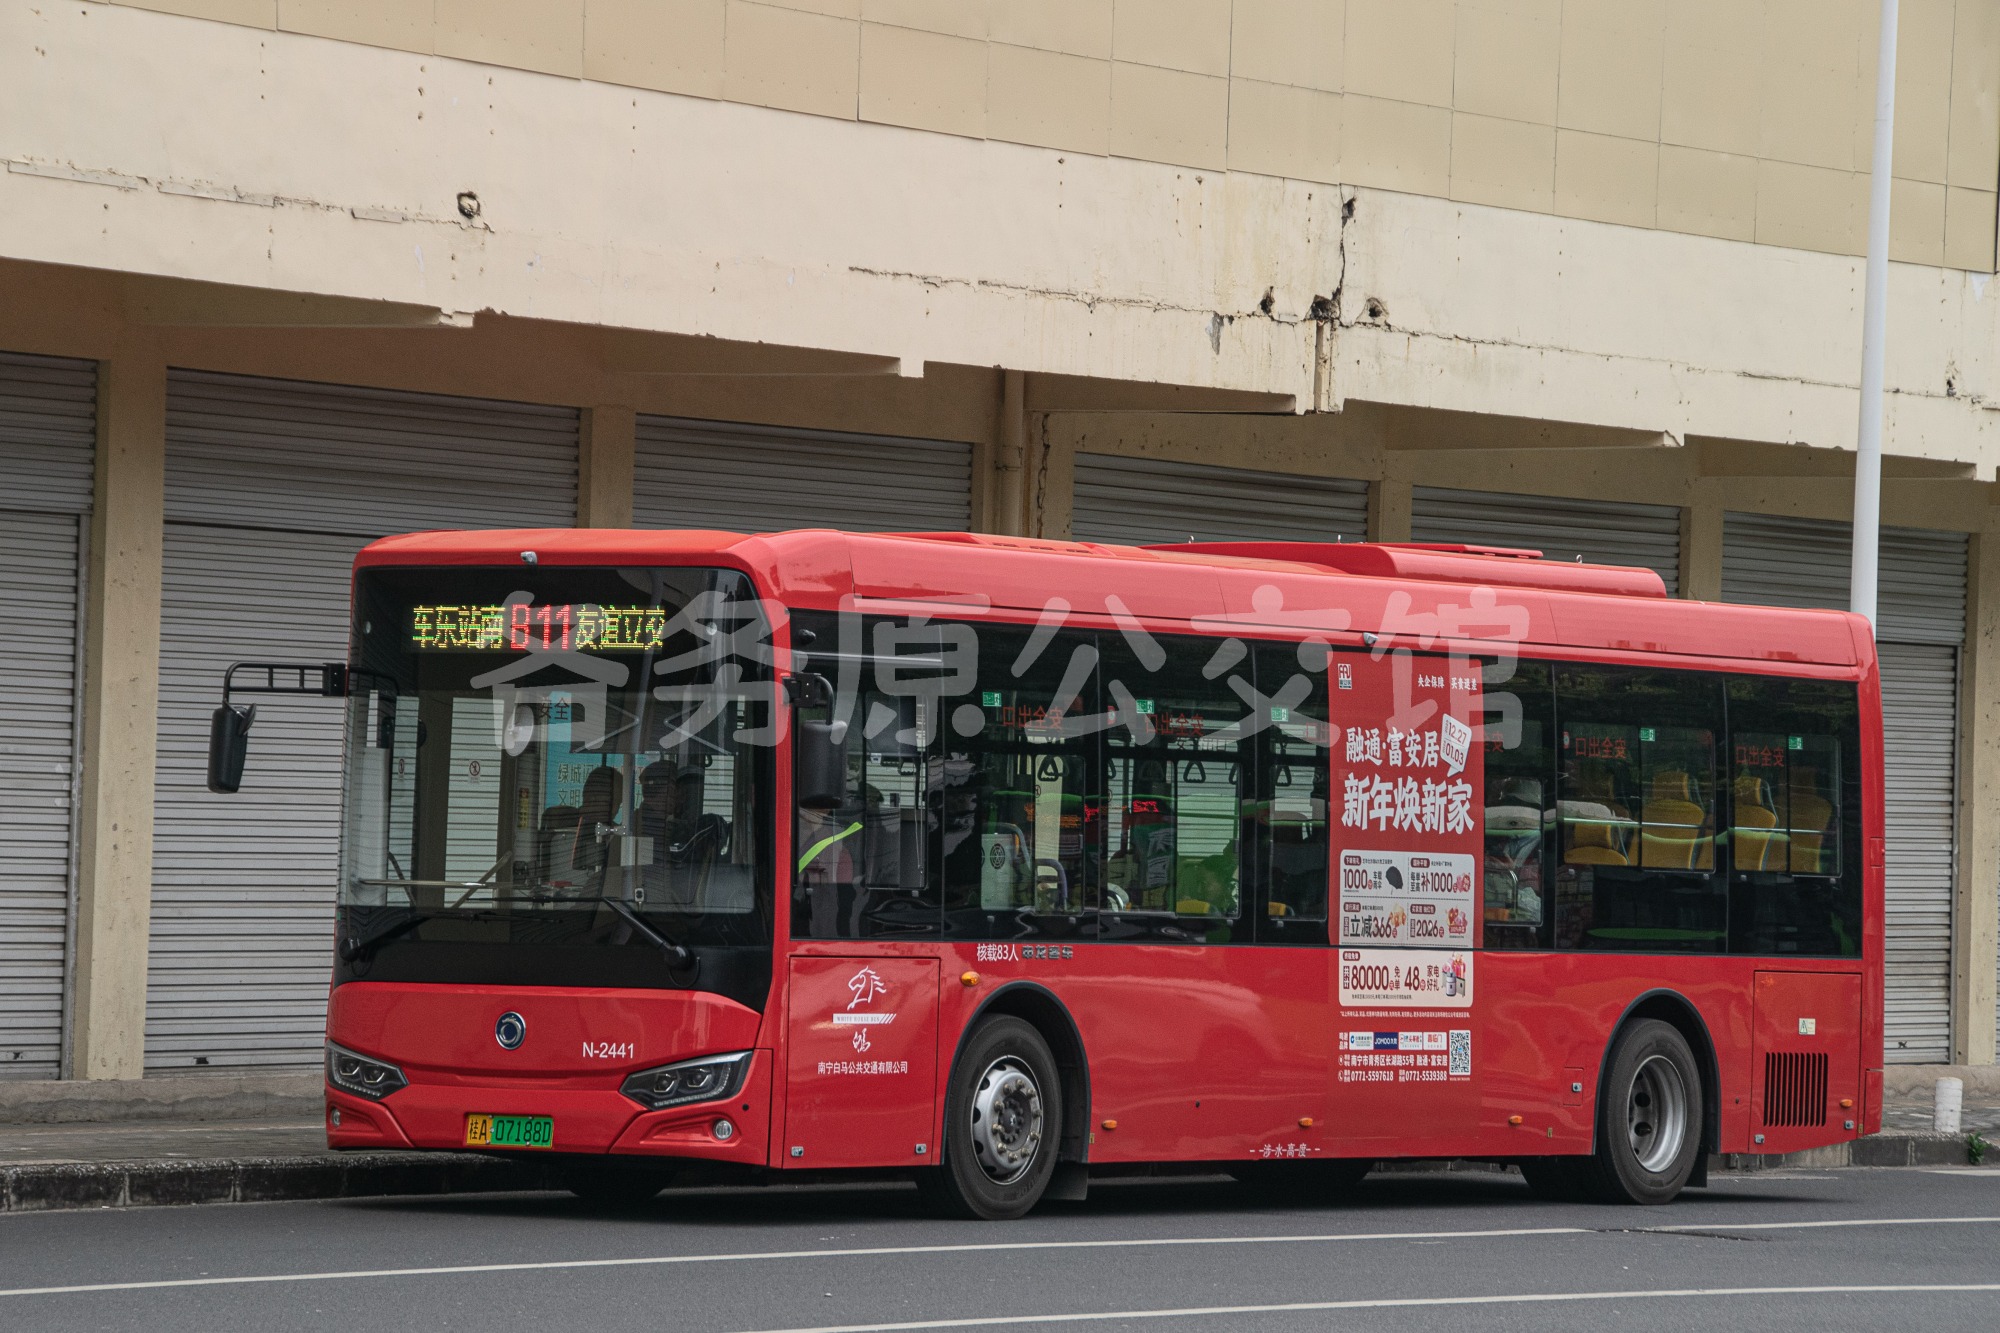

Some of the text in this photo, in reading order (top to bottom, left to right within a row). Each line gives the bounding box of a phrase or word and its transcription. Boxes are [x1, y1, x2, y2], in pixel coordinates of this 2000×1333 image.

[511, 604, 570, 650] B11
[1346, 727, 1440, 769] 融通·富安居
[1342, 772, 1475, 835] 新年焕新家
[977, 943, 1019, 961] 核载83人
[582, 1042, 635, 1059] N-2441
[818, 1061, 908, 1075] 南宁白马公共交通有限公司
[469, 1119, 552, 1143] 桂A 07188D
[1263, 1143, 1307, 1158] 涉水高度
